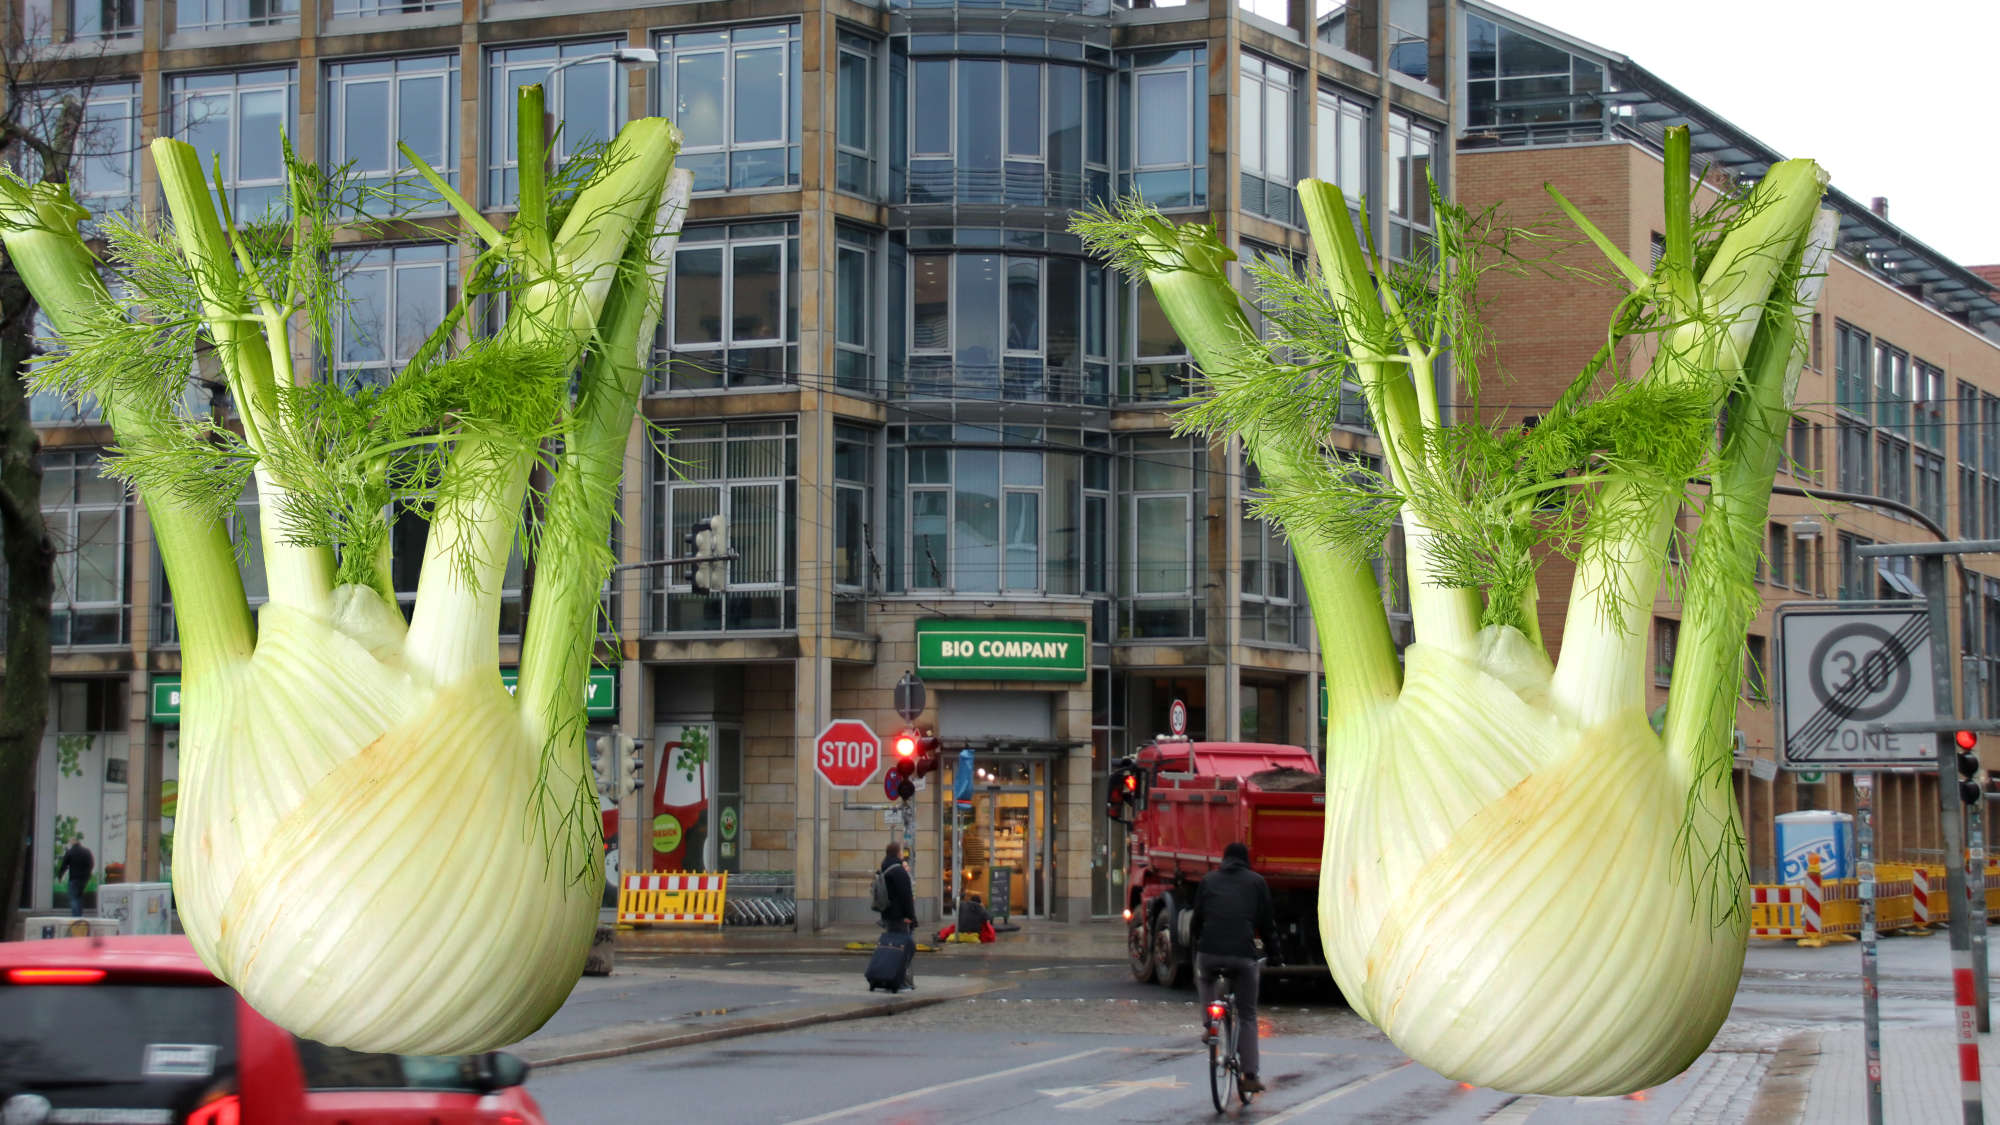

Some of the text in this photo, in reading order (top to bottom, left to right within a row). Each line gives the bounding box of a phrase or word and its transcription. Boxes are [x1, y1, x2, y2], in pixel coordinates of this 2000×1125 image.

[941, 640, 1069, 659] BIO COMPANY
[1829, 649, 1889, 694] 30
[1824, 728, 1901, 752] ZONE
[821, 741, 875, 768] STOP
